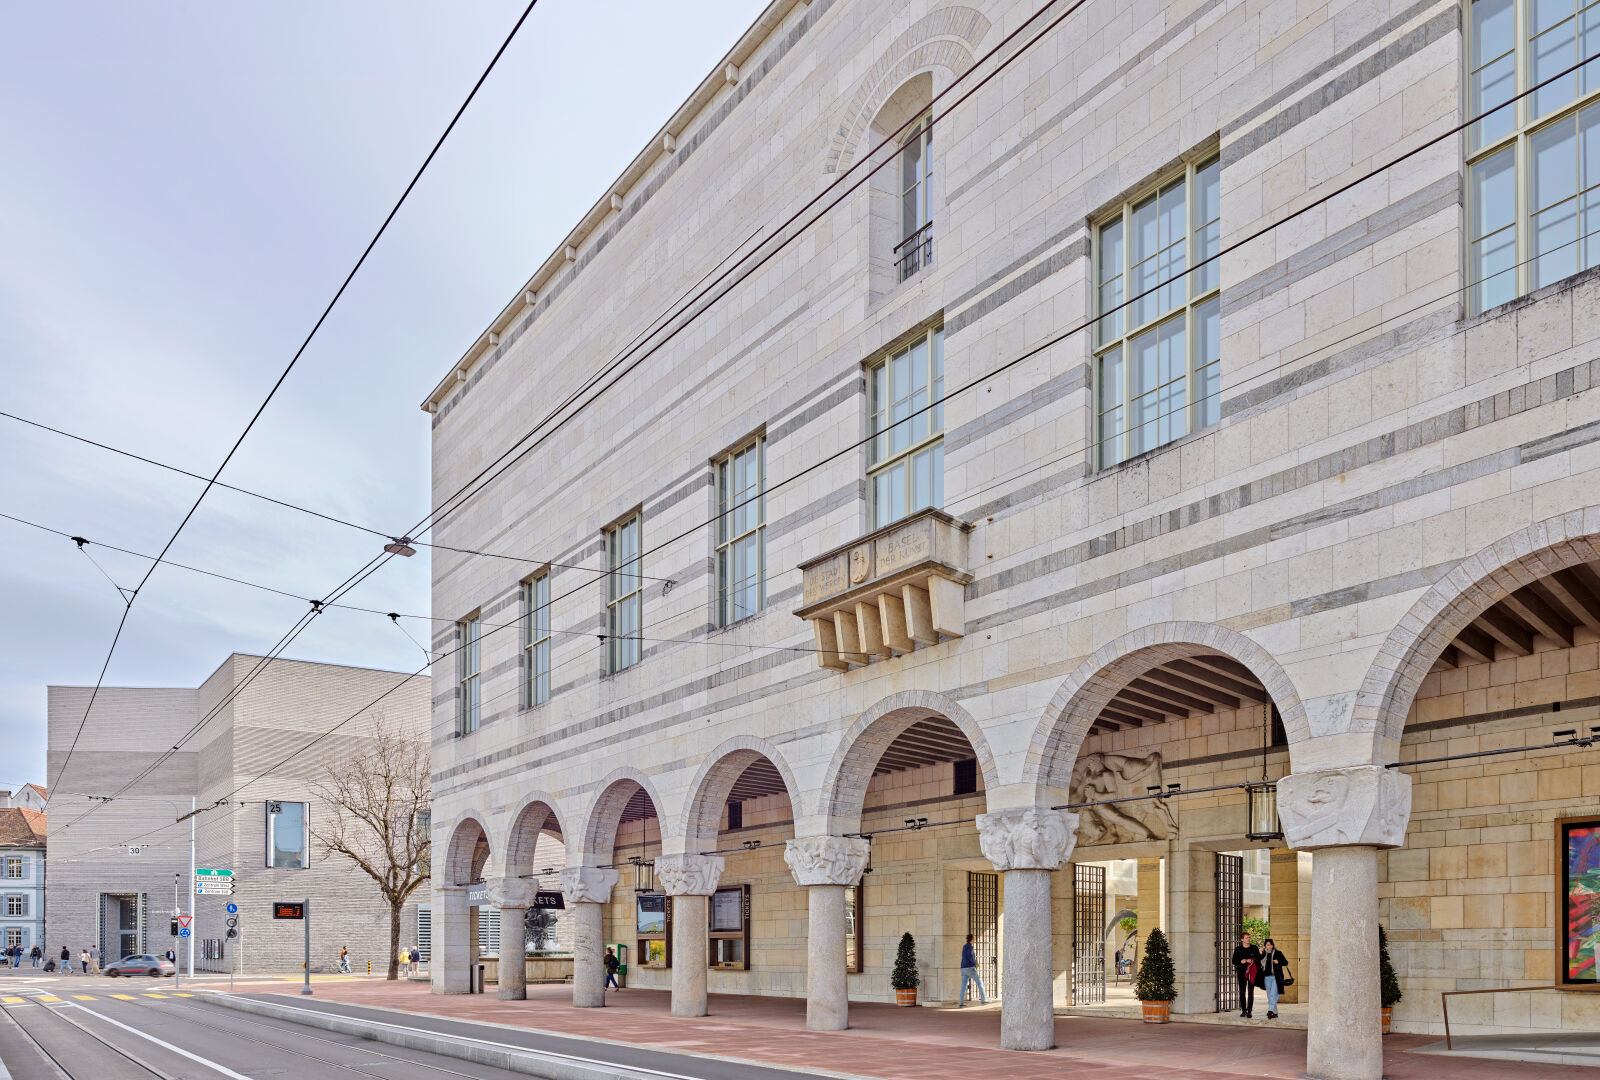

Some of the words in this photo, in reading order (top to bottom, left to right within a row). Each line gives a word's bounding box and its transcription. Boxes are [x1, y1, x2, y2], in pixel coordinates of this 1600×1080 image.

[888, 533, 920, 553] BASEL
[880, 554, 897, 568] DER
[900, 541, 926, 560] KUNST
[270, 803, 281, 813] 25
[534, 896, 556, 905] KETS
